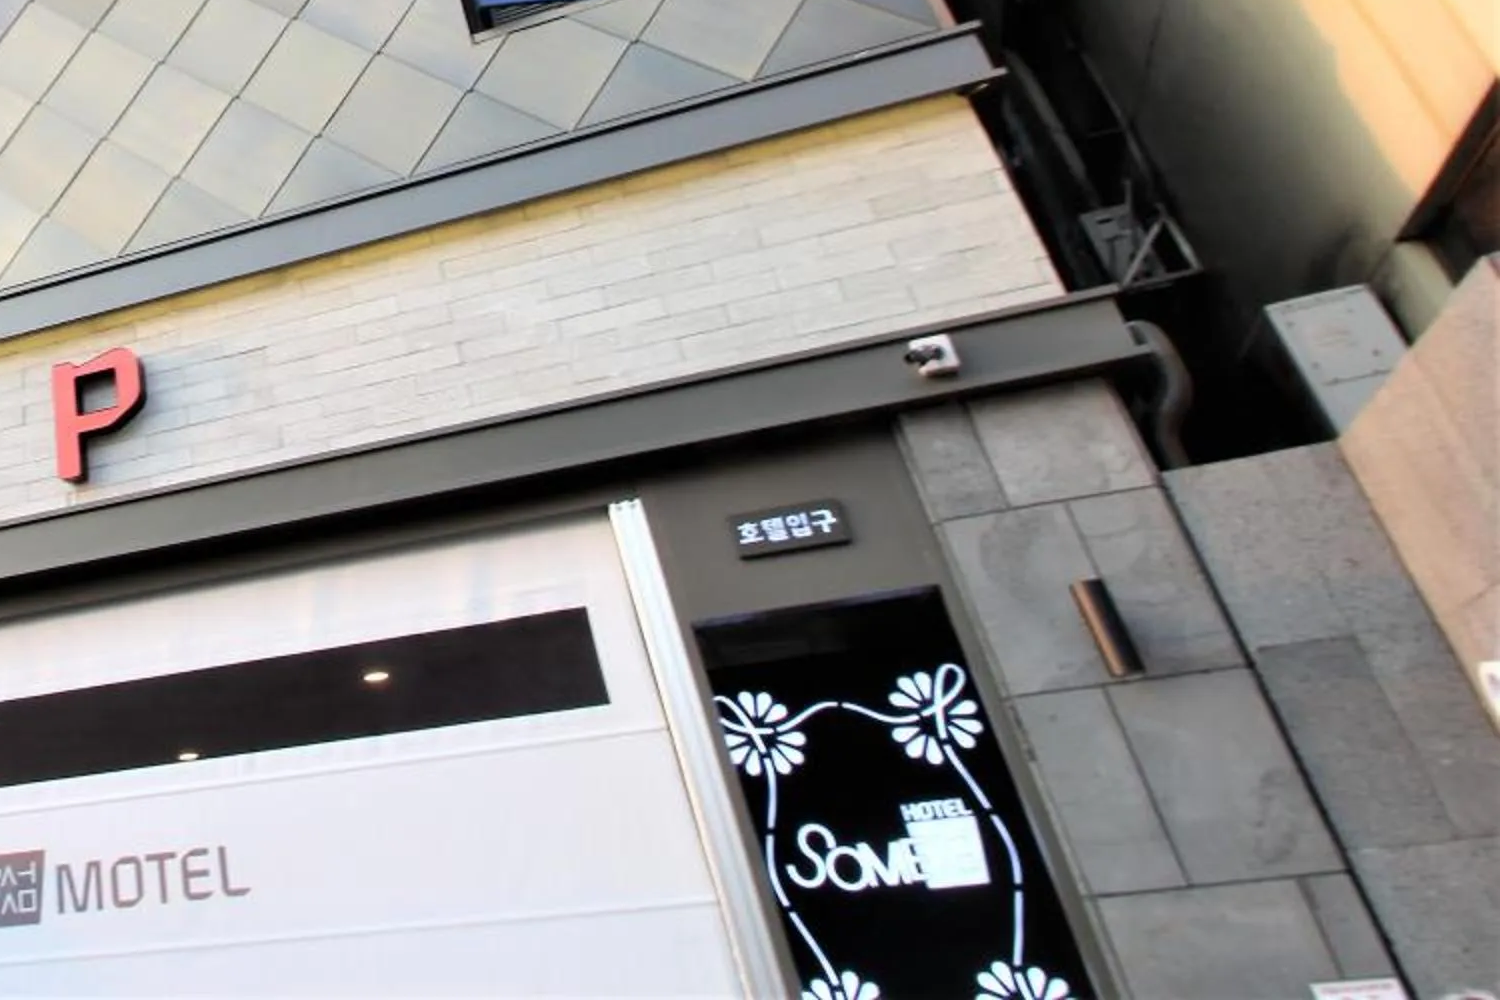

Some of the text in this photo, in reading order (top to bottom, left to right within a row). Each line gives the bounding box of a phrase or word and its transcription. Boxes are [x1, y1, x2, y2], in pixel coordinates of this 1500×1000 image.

[51, 346, 146, 483] P
[738, 509, 837, 545] 호텔입구
[900, 797, 973, 822] HOTEL
[55, 845, 252, 914] MOTEL
